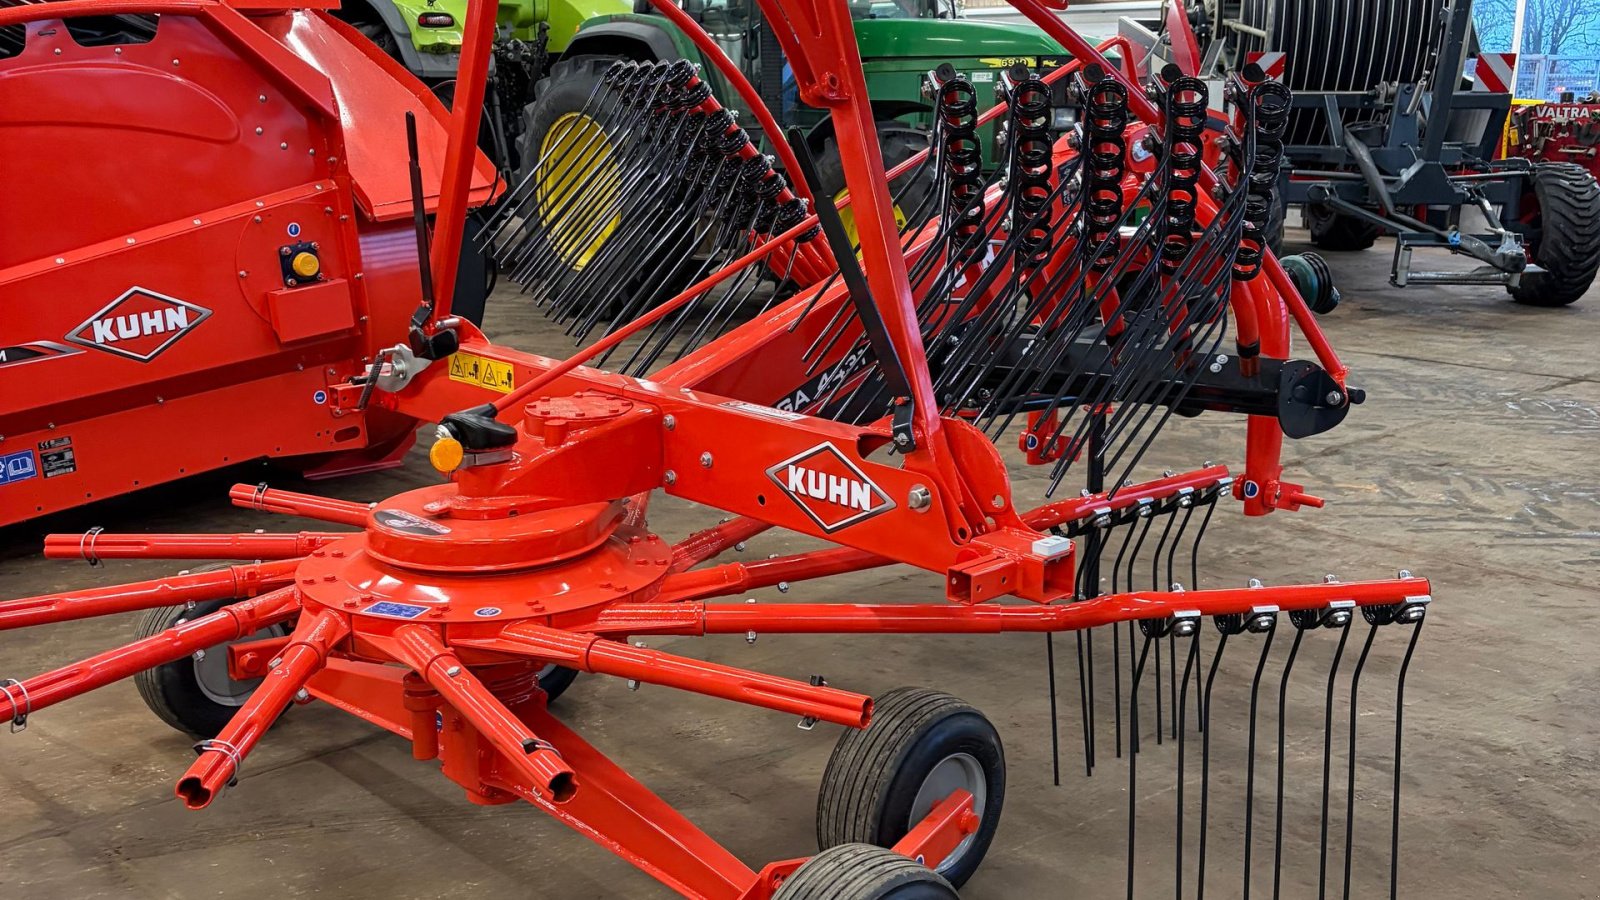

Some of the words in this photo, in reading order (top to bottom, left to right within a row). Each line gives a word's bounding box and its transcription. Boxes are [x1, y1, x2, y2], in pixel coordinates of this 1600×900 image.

[1001, 59, 1027, 67] 690
[1536, 106, 1590, 118] VALTRA
[92, 306, 189, 344] KUHN
[788, 464, 871, 512] KUHN
